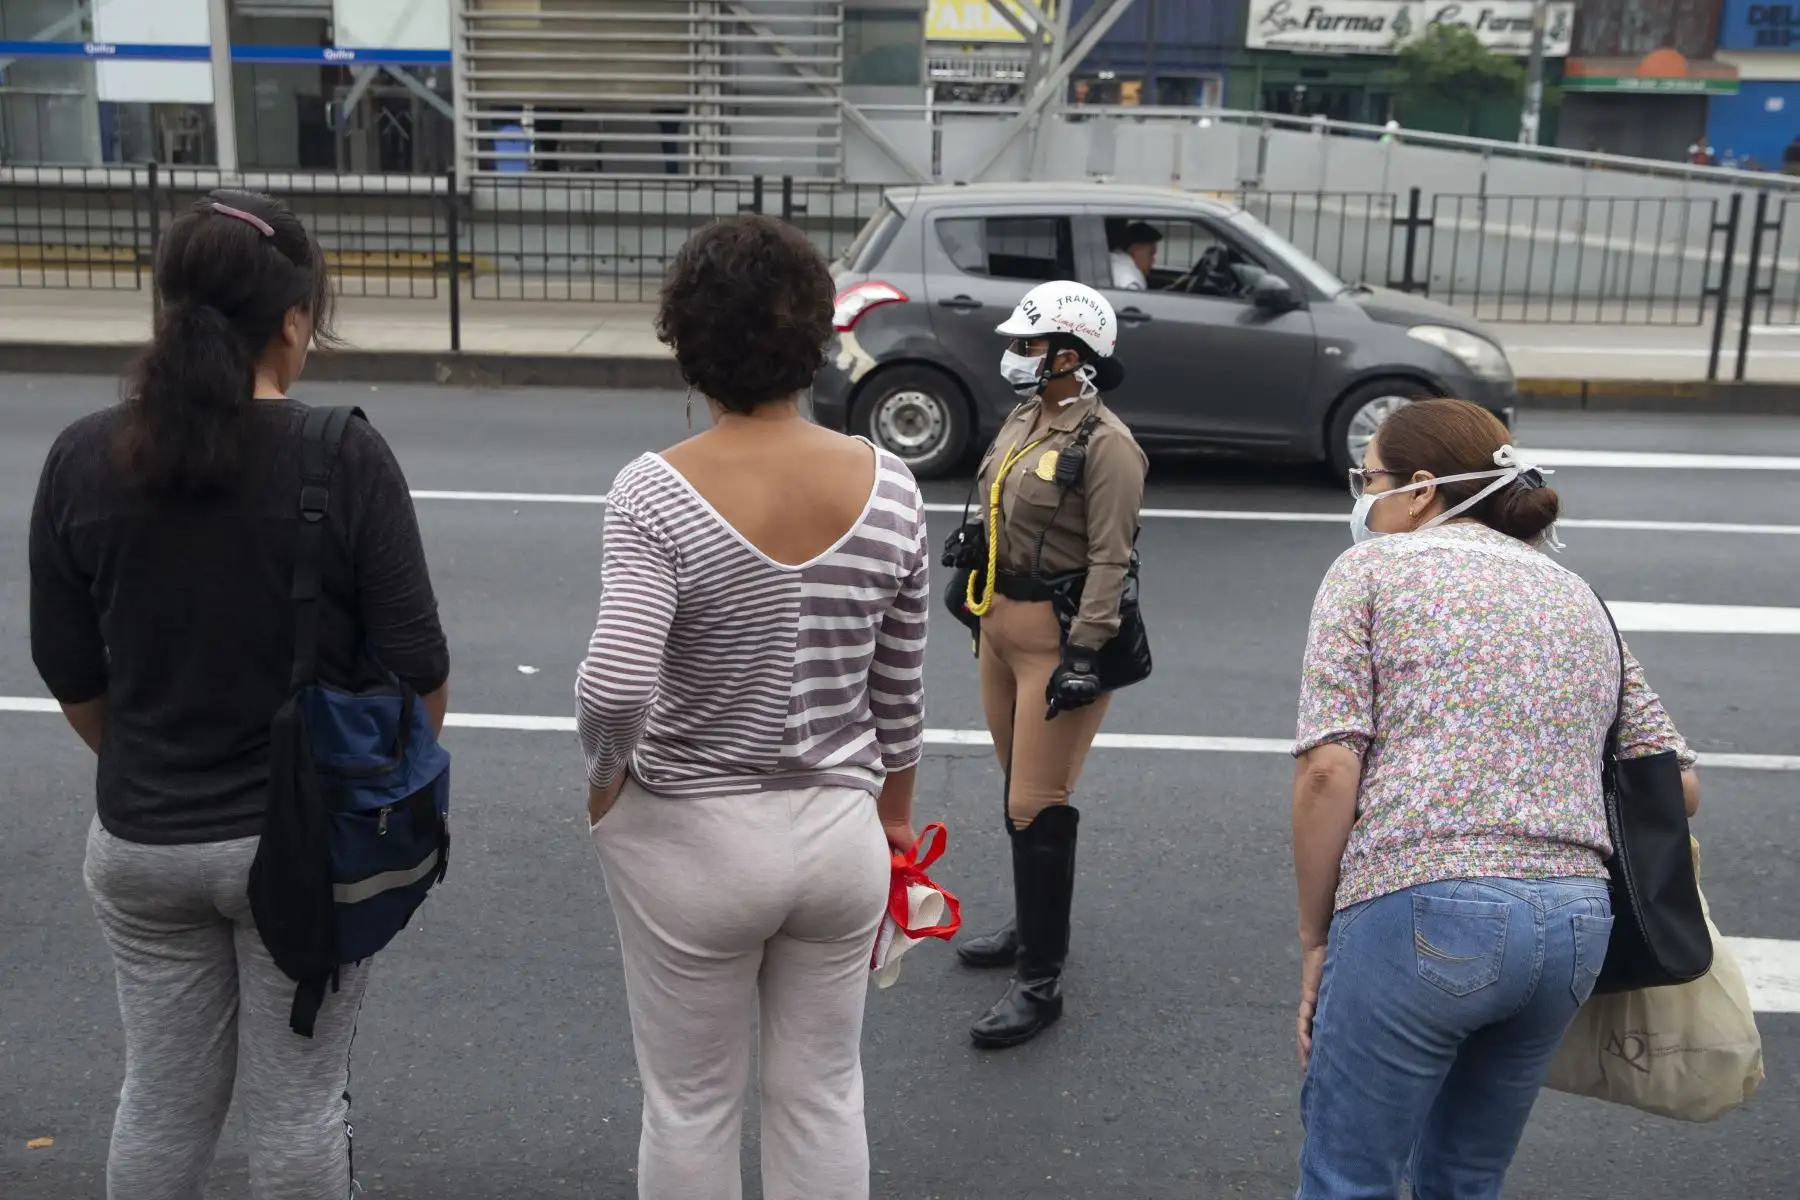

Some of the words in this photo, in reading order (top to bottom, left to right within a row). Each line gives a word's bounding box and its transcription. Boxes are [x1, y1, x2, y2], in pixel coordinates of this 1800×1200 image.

[1303, 6, 1385, 31] Farma
[1476, 8, 1536, 31] Farm
[1057, 295, 1106, 326] TRANSITO
[1051, 314, 1074, 328] Lima
[1075, 321, 1101, 338] Centro
